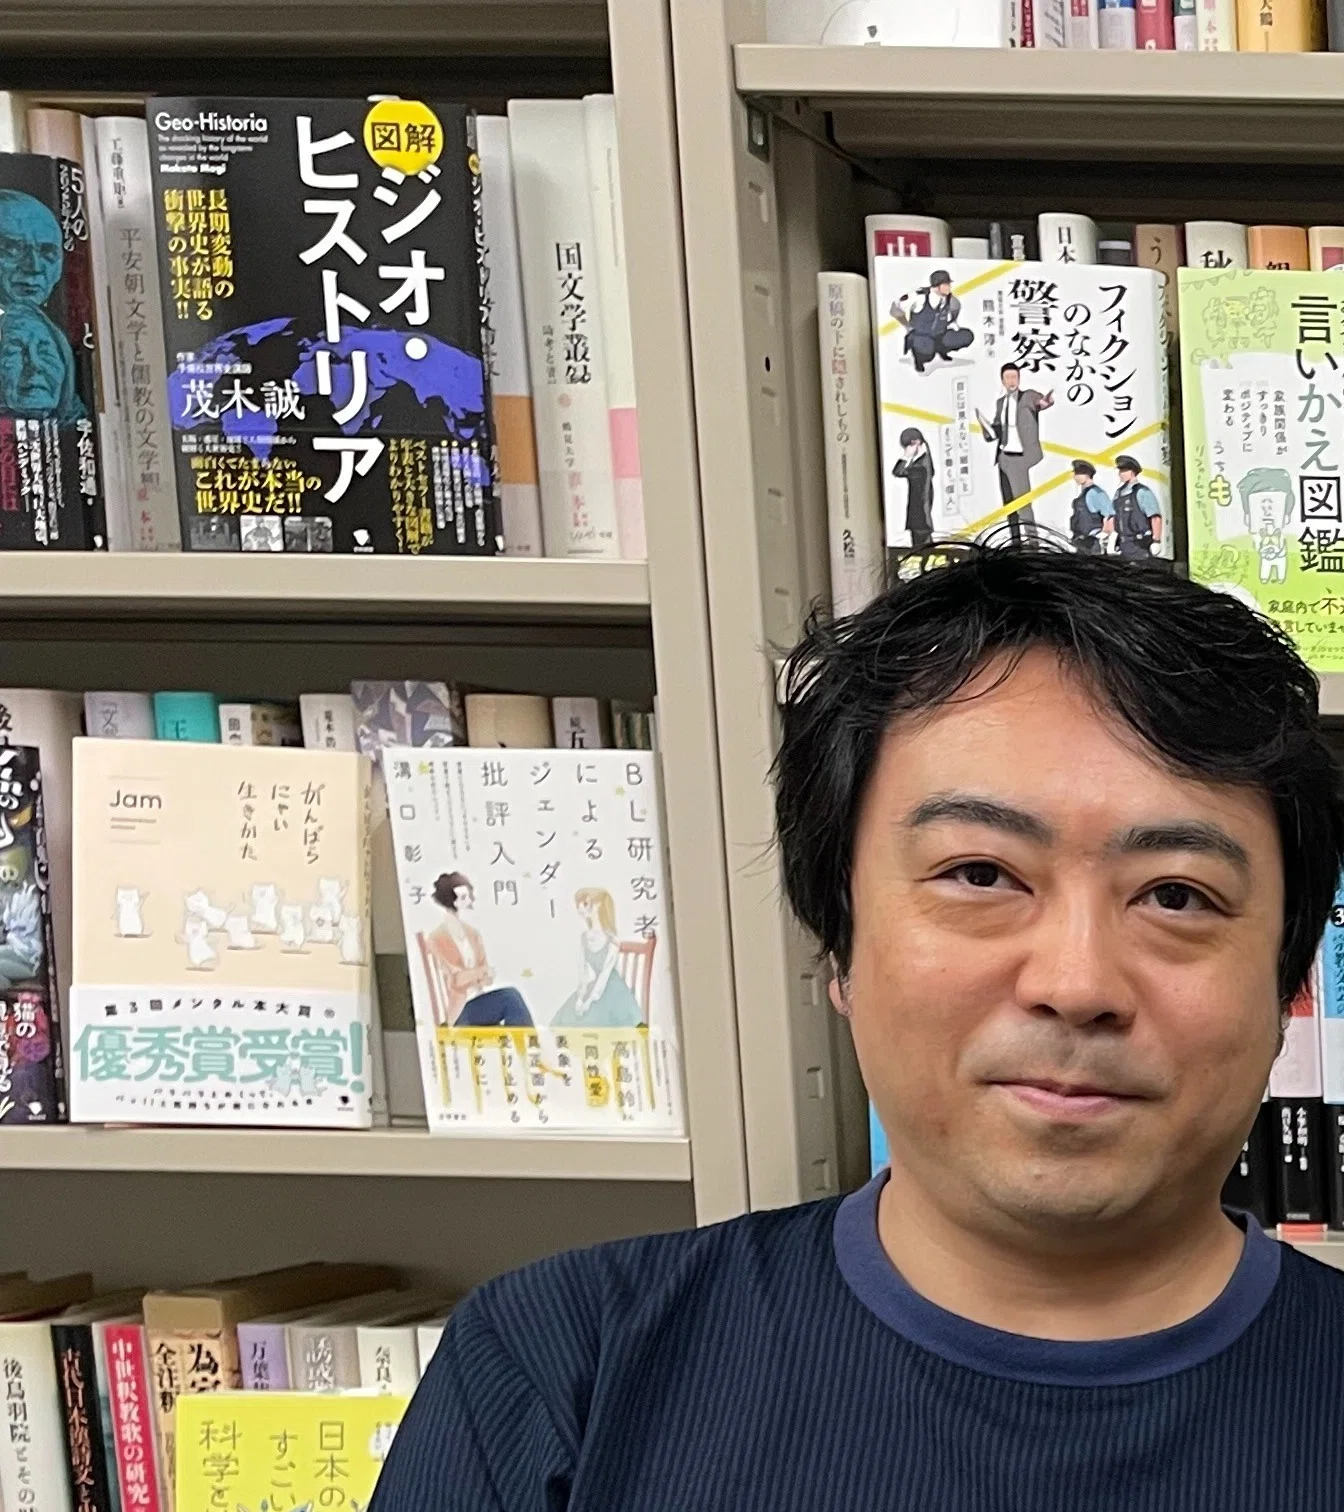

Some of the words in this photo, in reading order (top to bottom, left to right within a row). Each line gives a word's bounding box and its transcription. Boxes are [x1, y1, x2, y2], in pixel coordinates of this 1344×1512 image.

[154, 112, 268, 132] Geo-Historia
[371, 122, 436, 154] 図解
[186, 189, 213, 321] 世界史が語る
[208, 189, 235, 299] 長期変動の
[296, 115, 385, 503] ヒストリア
[1008, 278, 1061, 373] 警察
[1063, 303, 1095, 407] のなかの
[181, 378, 306, 420] 茂木誠
[1098, 283, 1139, 440] フィクション
[195, 471, 322, 493] これが本当の
[110, 790, 162, 809] Jam
[272, 784, 291, 832] にゃい
[301, 780, 326, 865] がんばら
[393, 760, 427, 905] 溝口彰子
[481, 760, 520, 907] 批評入門
[529, 760, 562, 919] ジェンダー
[576, 763, 604, 861] による
[623, 761, 660, 940] BL研究者
[73, 1019, 366, 1093] 優秀賞受賞!
[269, 1428, 299, 1511] すごい
[314, 1420, 350, 1508] 日本の
